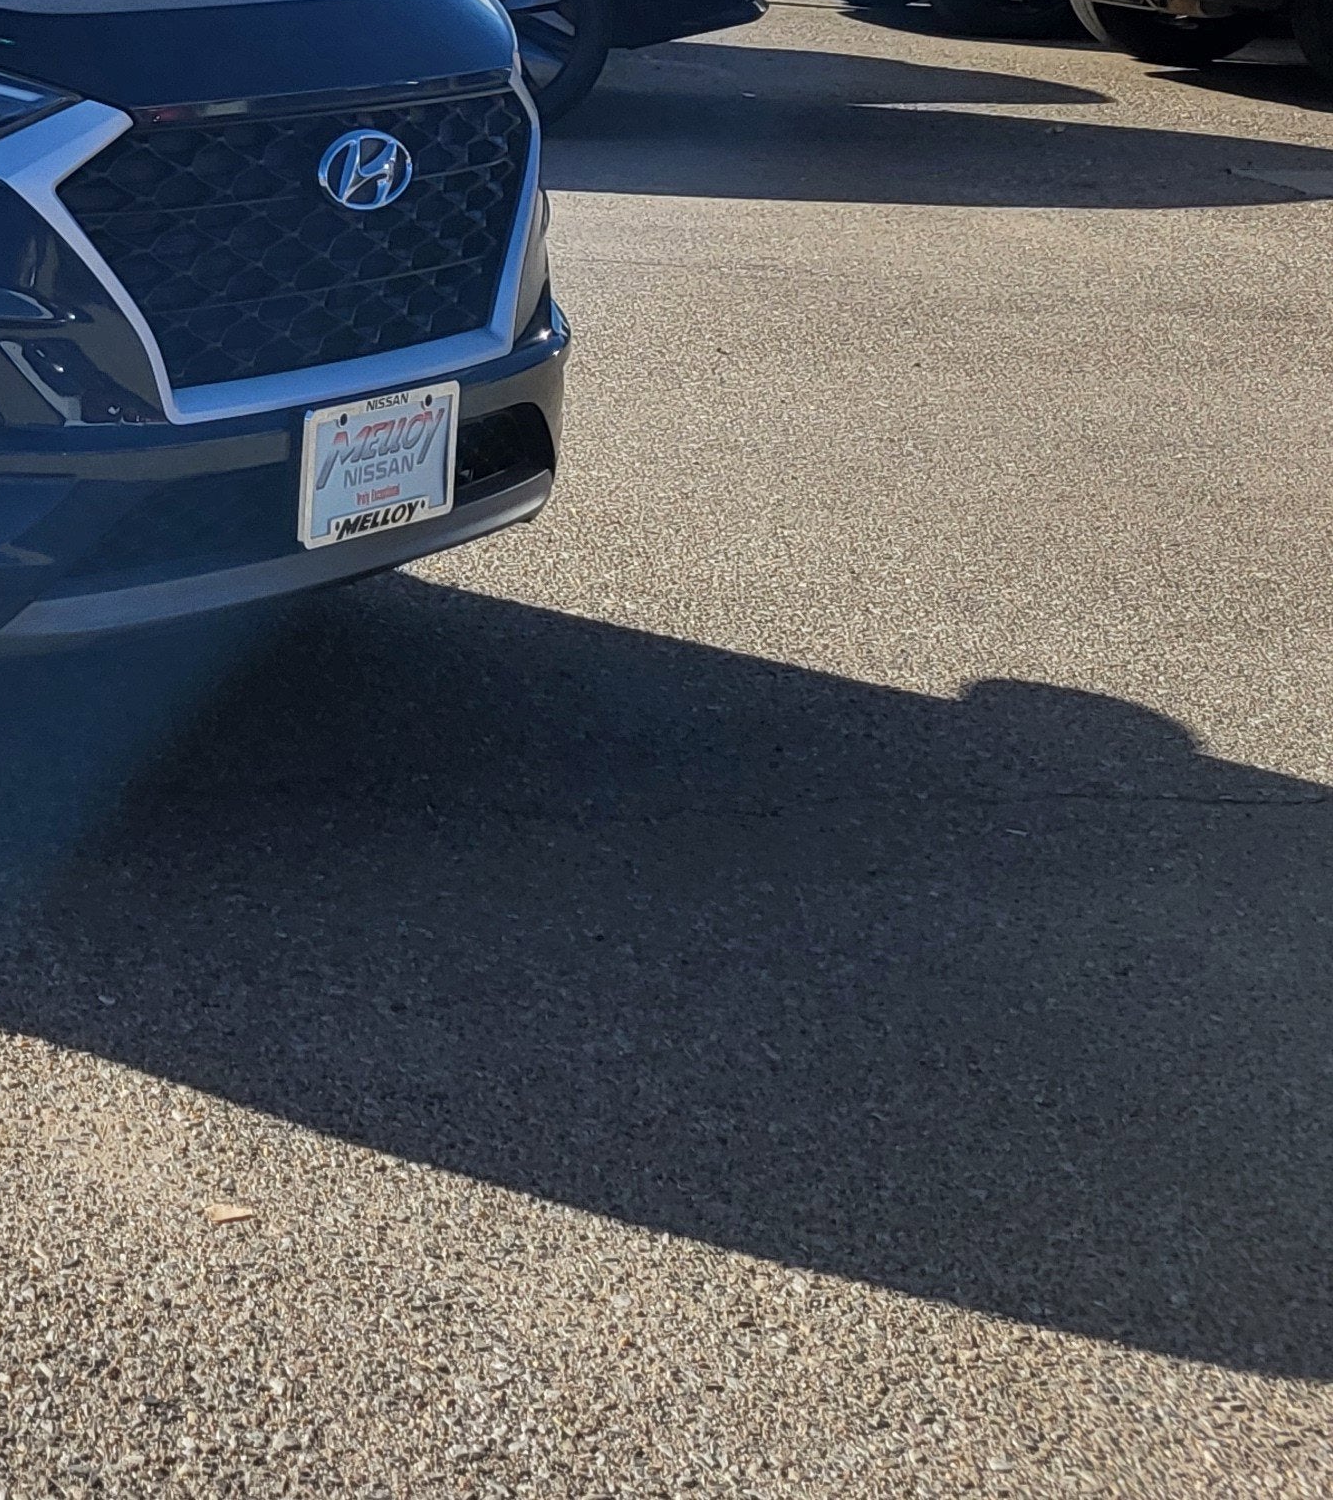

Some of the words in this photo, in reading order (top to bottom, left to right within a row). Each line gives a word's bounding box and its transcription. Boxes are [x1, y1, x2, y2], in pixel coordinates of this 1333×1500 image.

[365, 392, 410, 412] NISSAN
[315, 407, 445, 490] MELLOY
[343, 453, 414, 489] NISSAN
[336, 500, 420, 540] MELLOY
